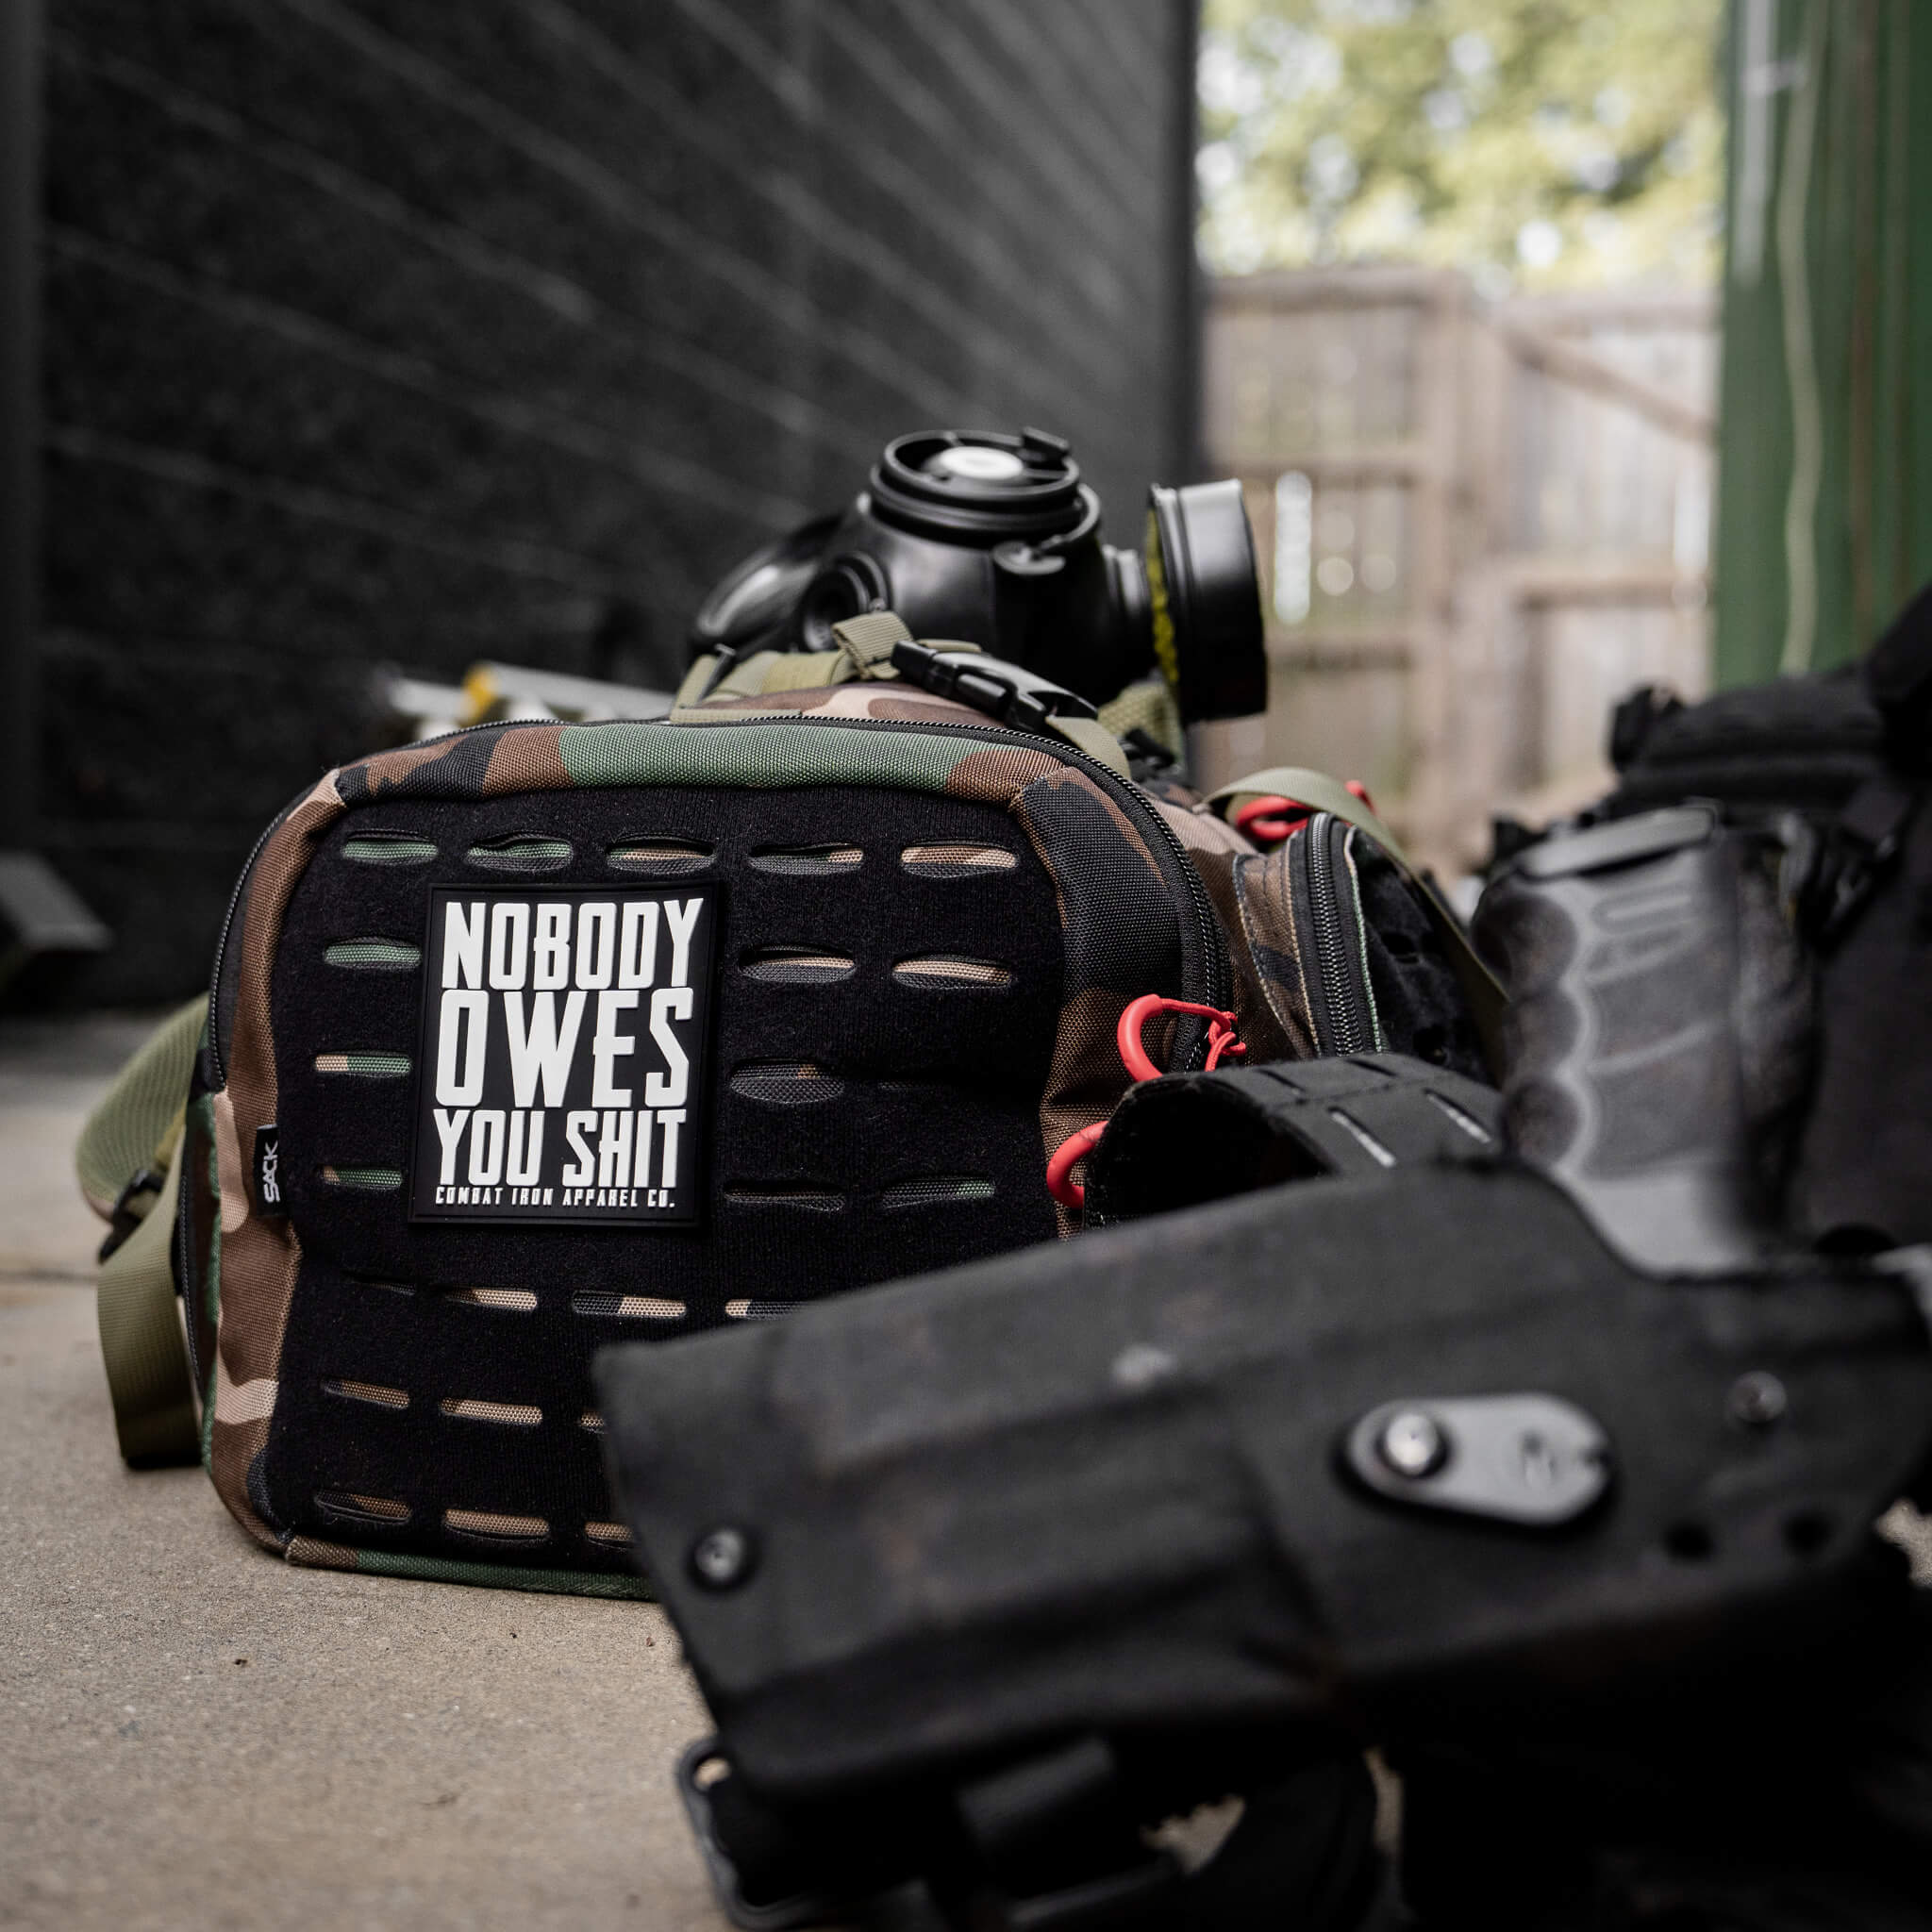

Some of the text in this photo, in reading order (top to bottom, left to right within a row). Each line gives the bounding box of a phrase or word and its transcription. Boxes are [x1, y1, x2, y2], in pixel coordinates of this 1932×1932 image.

[441, 897, 704, 990] NOBODY
[435, 987, 693, 1108] OWES
[433, 1109, 687, 1188] YOU SHIT
[435, 1186, 675, 1208] COMBAT IRON APPAREL CO.
